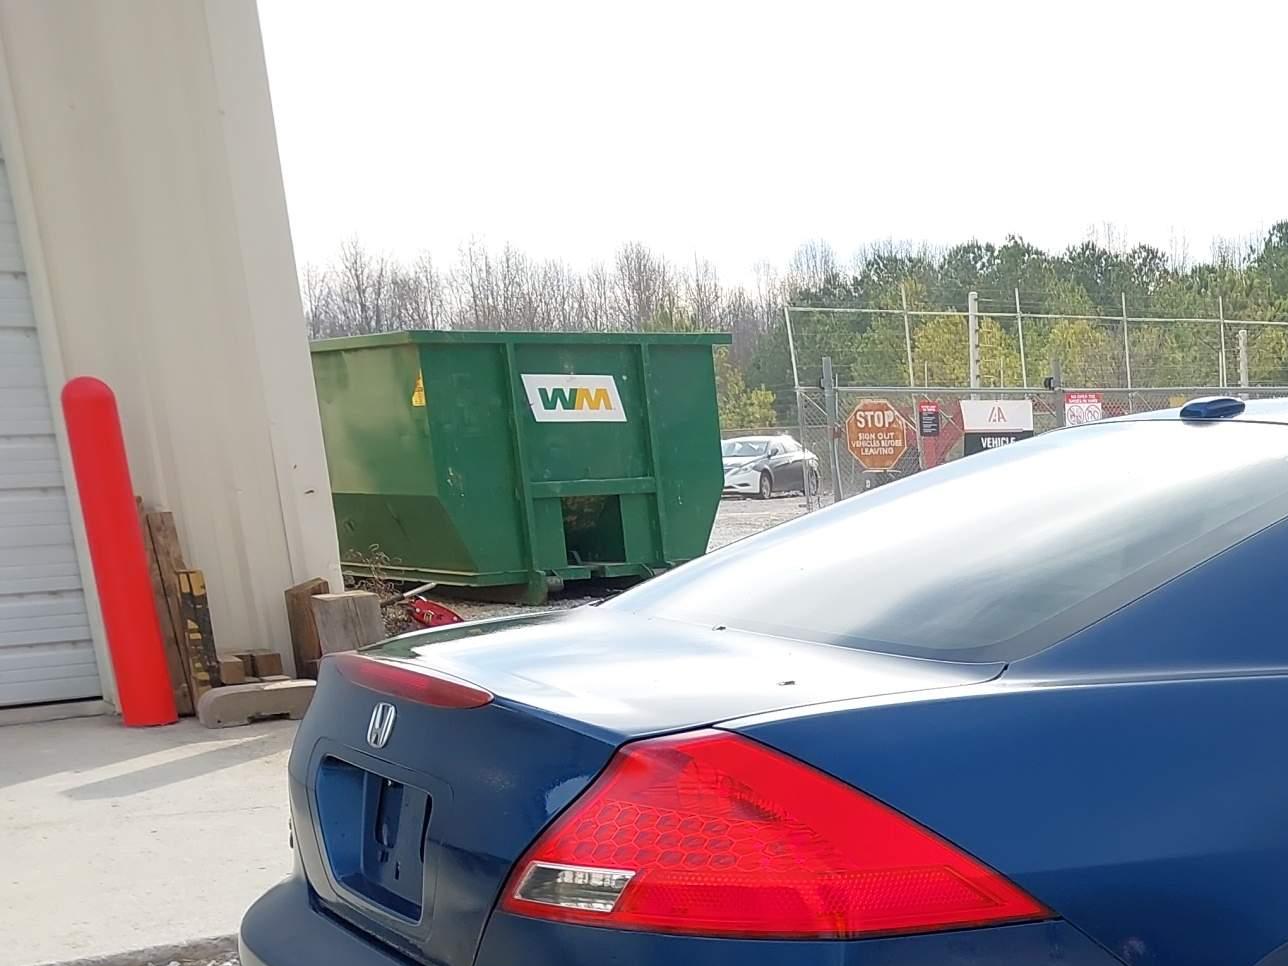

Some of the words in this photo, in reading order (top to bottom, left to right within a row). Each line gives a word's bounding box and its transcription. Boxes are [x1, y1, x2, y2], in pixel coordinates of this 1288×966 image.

[537, 386, 614, 411] WM
[856, 409, 895, 429] STOP
[858, 432, 876, 440] SIGN
[877, 432, 895, 440] OUT
[860, 447, 894, 456] LEAVING
